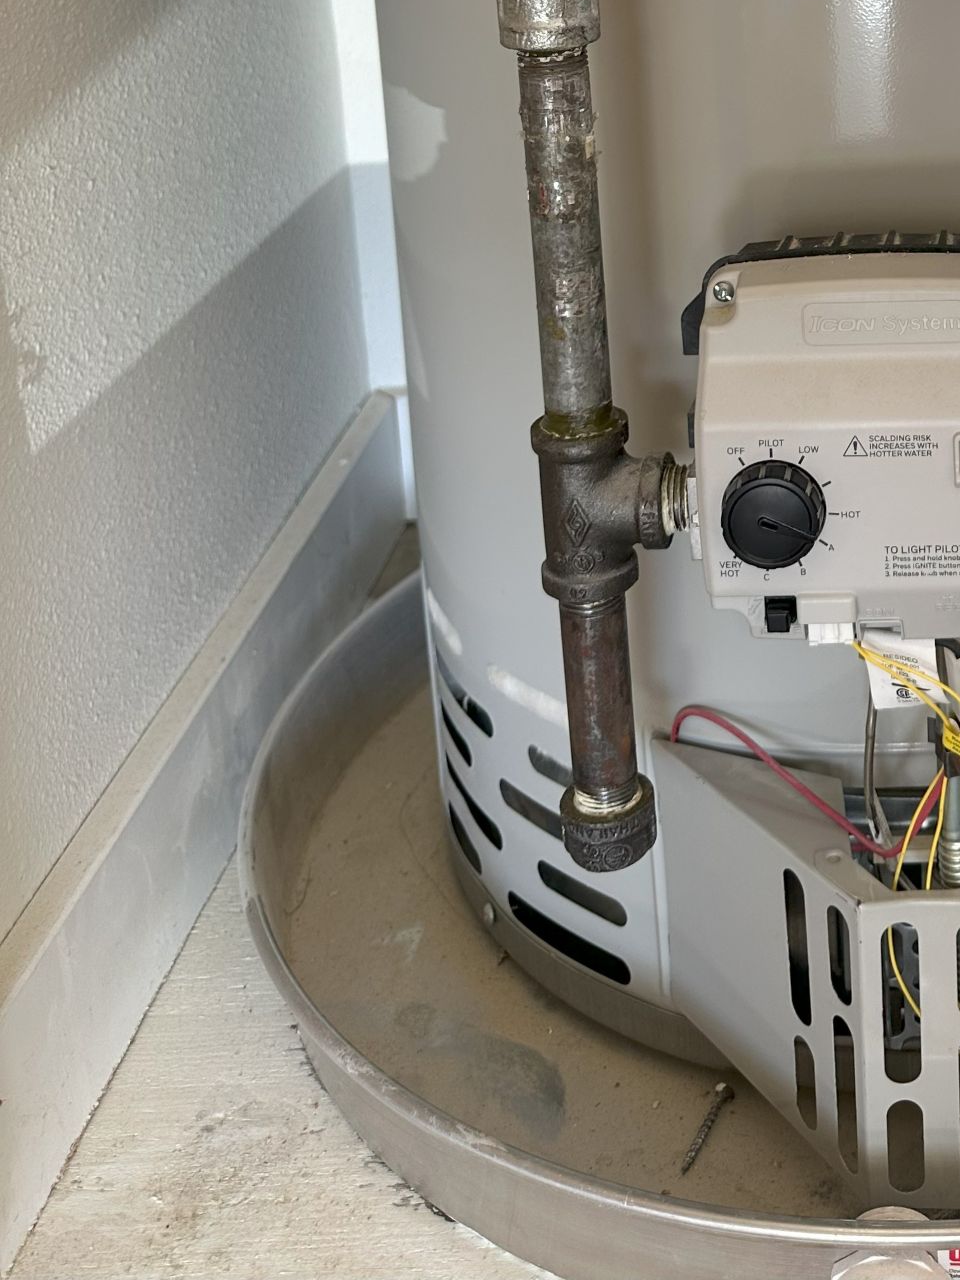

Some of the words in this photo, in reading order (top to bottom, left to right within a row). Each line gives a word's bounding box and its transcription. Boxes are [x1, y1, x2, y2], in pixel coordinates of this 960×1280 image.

[868, 434, 911, 443] SCALDING
[912, 434, 932, 442] RISK
[758, 439, 784, 448] PILOT
[869, 442, 916, 450] INCREASES
[727, 447, 745, 455] OFF
[798, 445, 819, 455] LOW
[869, 450, 903, 458] HOTTER
[841, 510, 860, 519] HOT
[884, 545, 899, 555] TO
[900, 544, 933, 554] LIGHT
[720, 560, 743, 569] VERY
[720, 569, 739, 578] HOT
[800, 568, 807, 576] B
[763, 573, 770, 581] C
